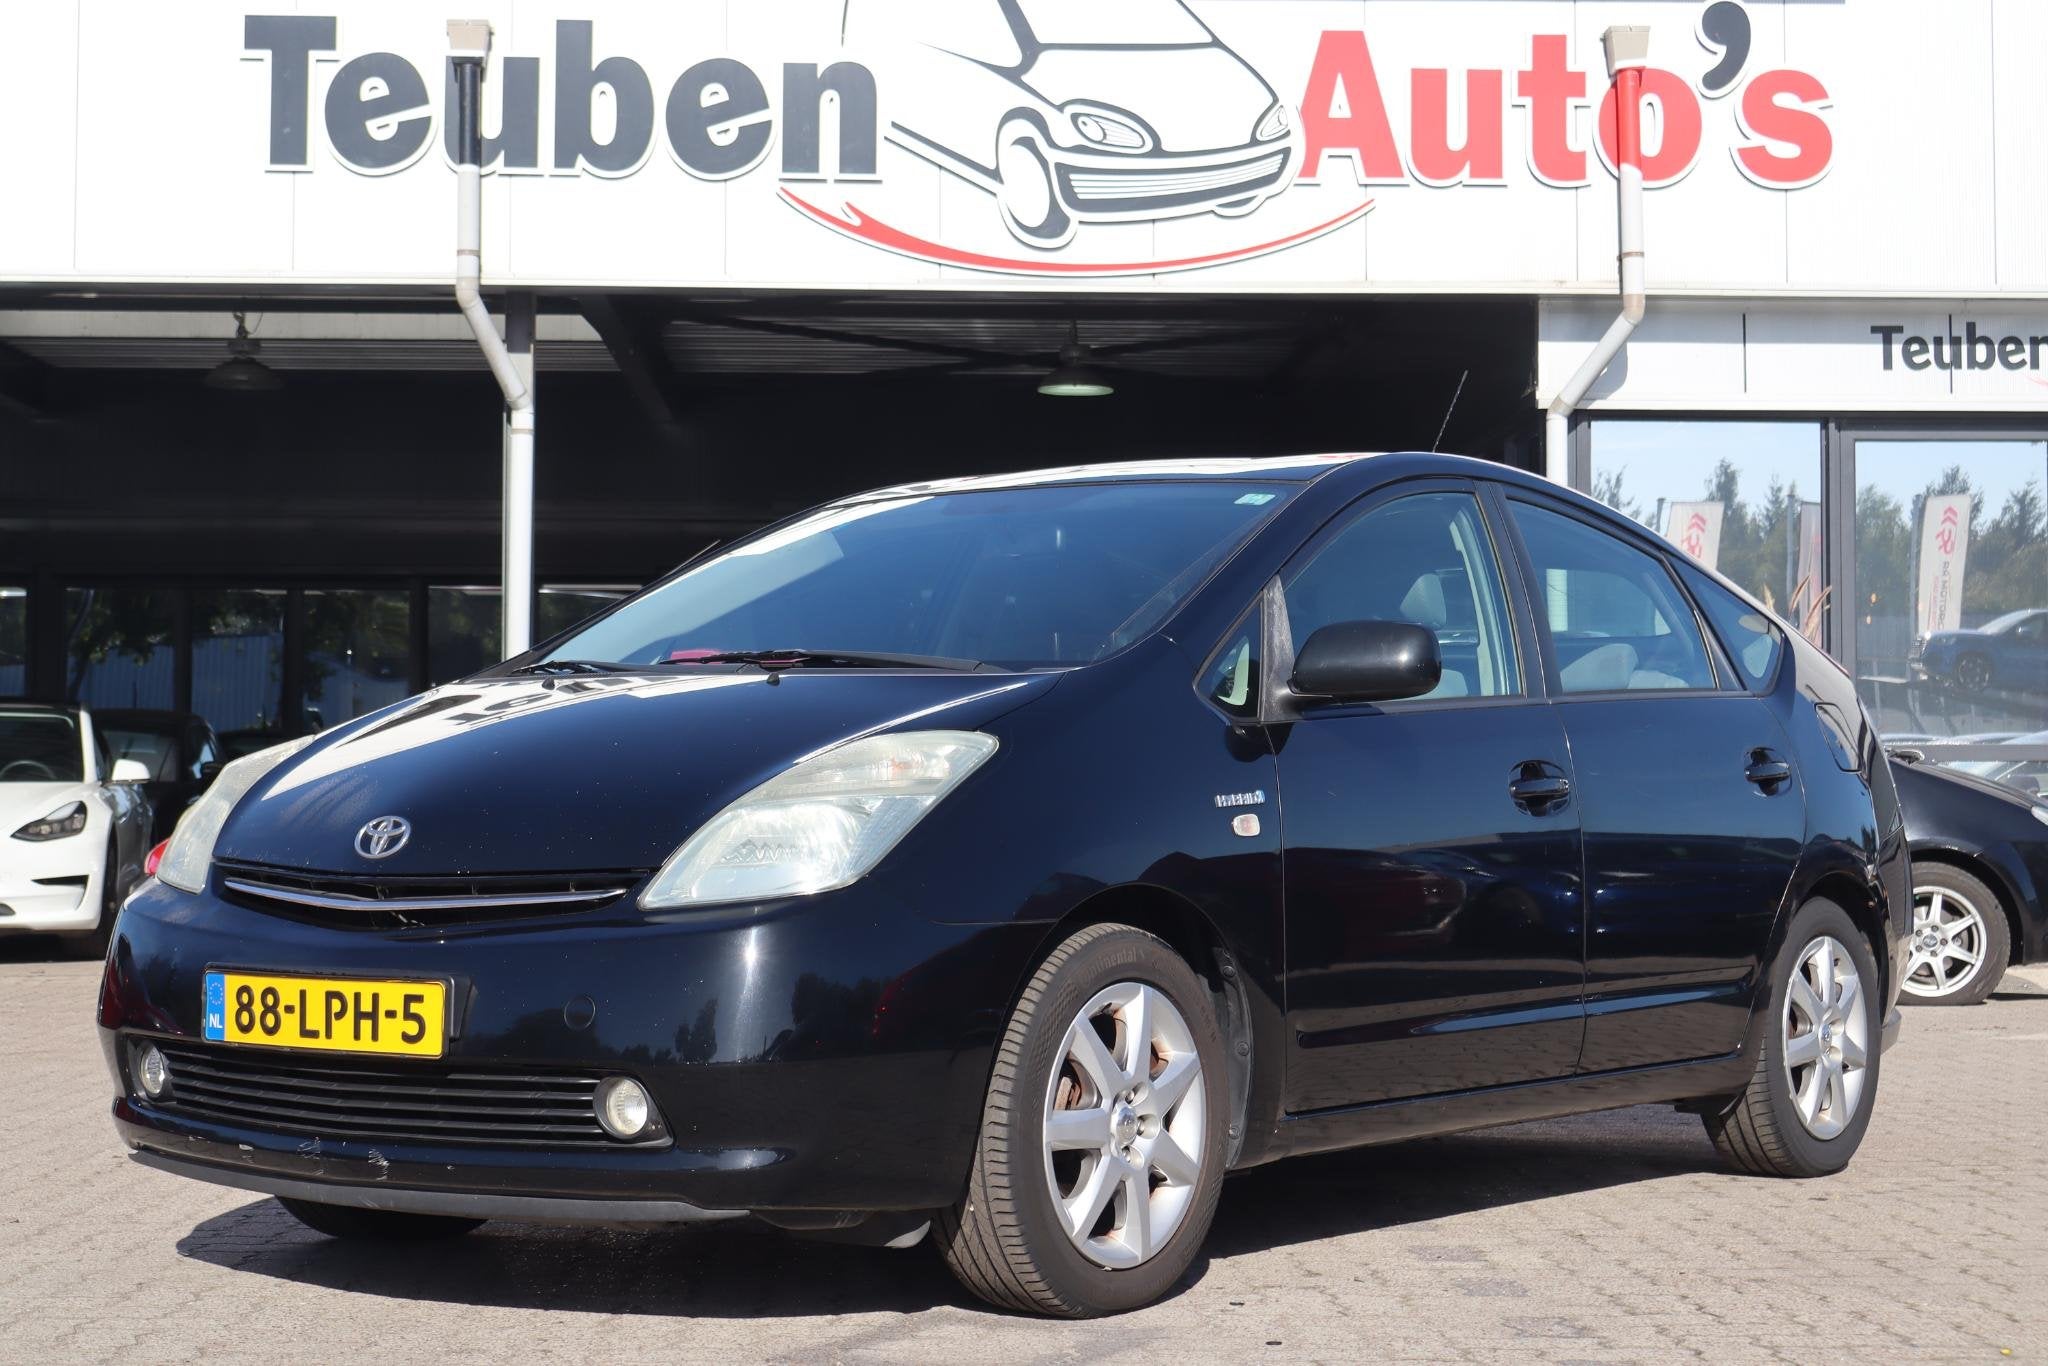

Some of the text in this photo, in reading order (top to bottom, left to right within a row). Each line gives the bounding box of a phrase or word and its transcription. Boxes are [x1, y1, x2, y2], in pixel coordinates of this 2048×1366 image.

[243, 1, 1834, 183] Teuben Auto's
[209, 1013, 223, 1029] NL
[234, 984, 426, 1045] 88-LPH-5
